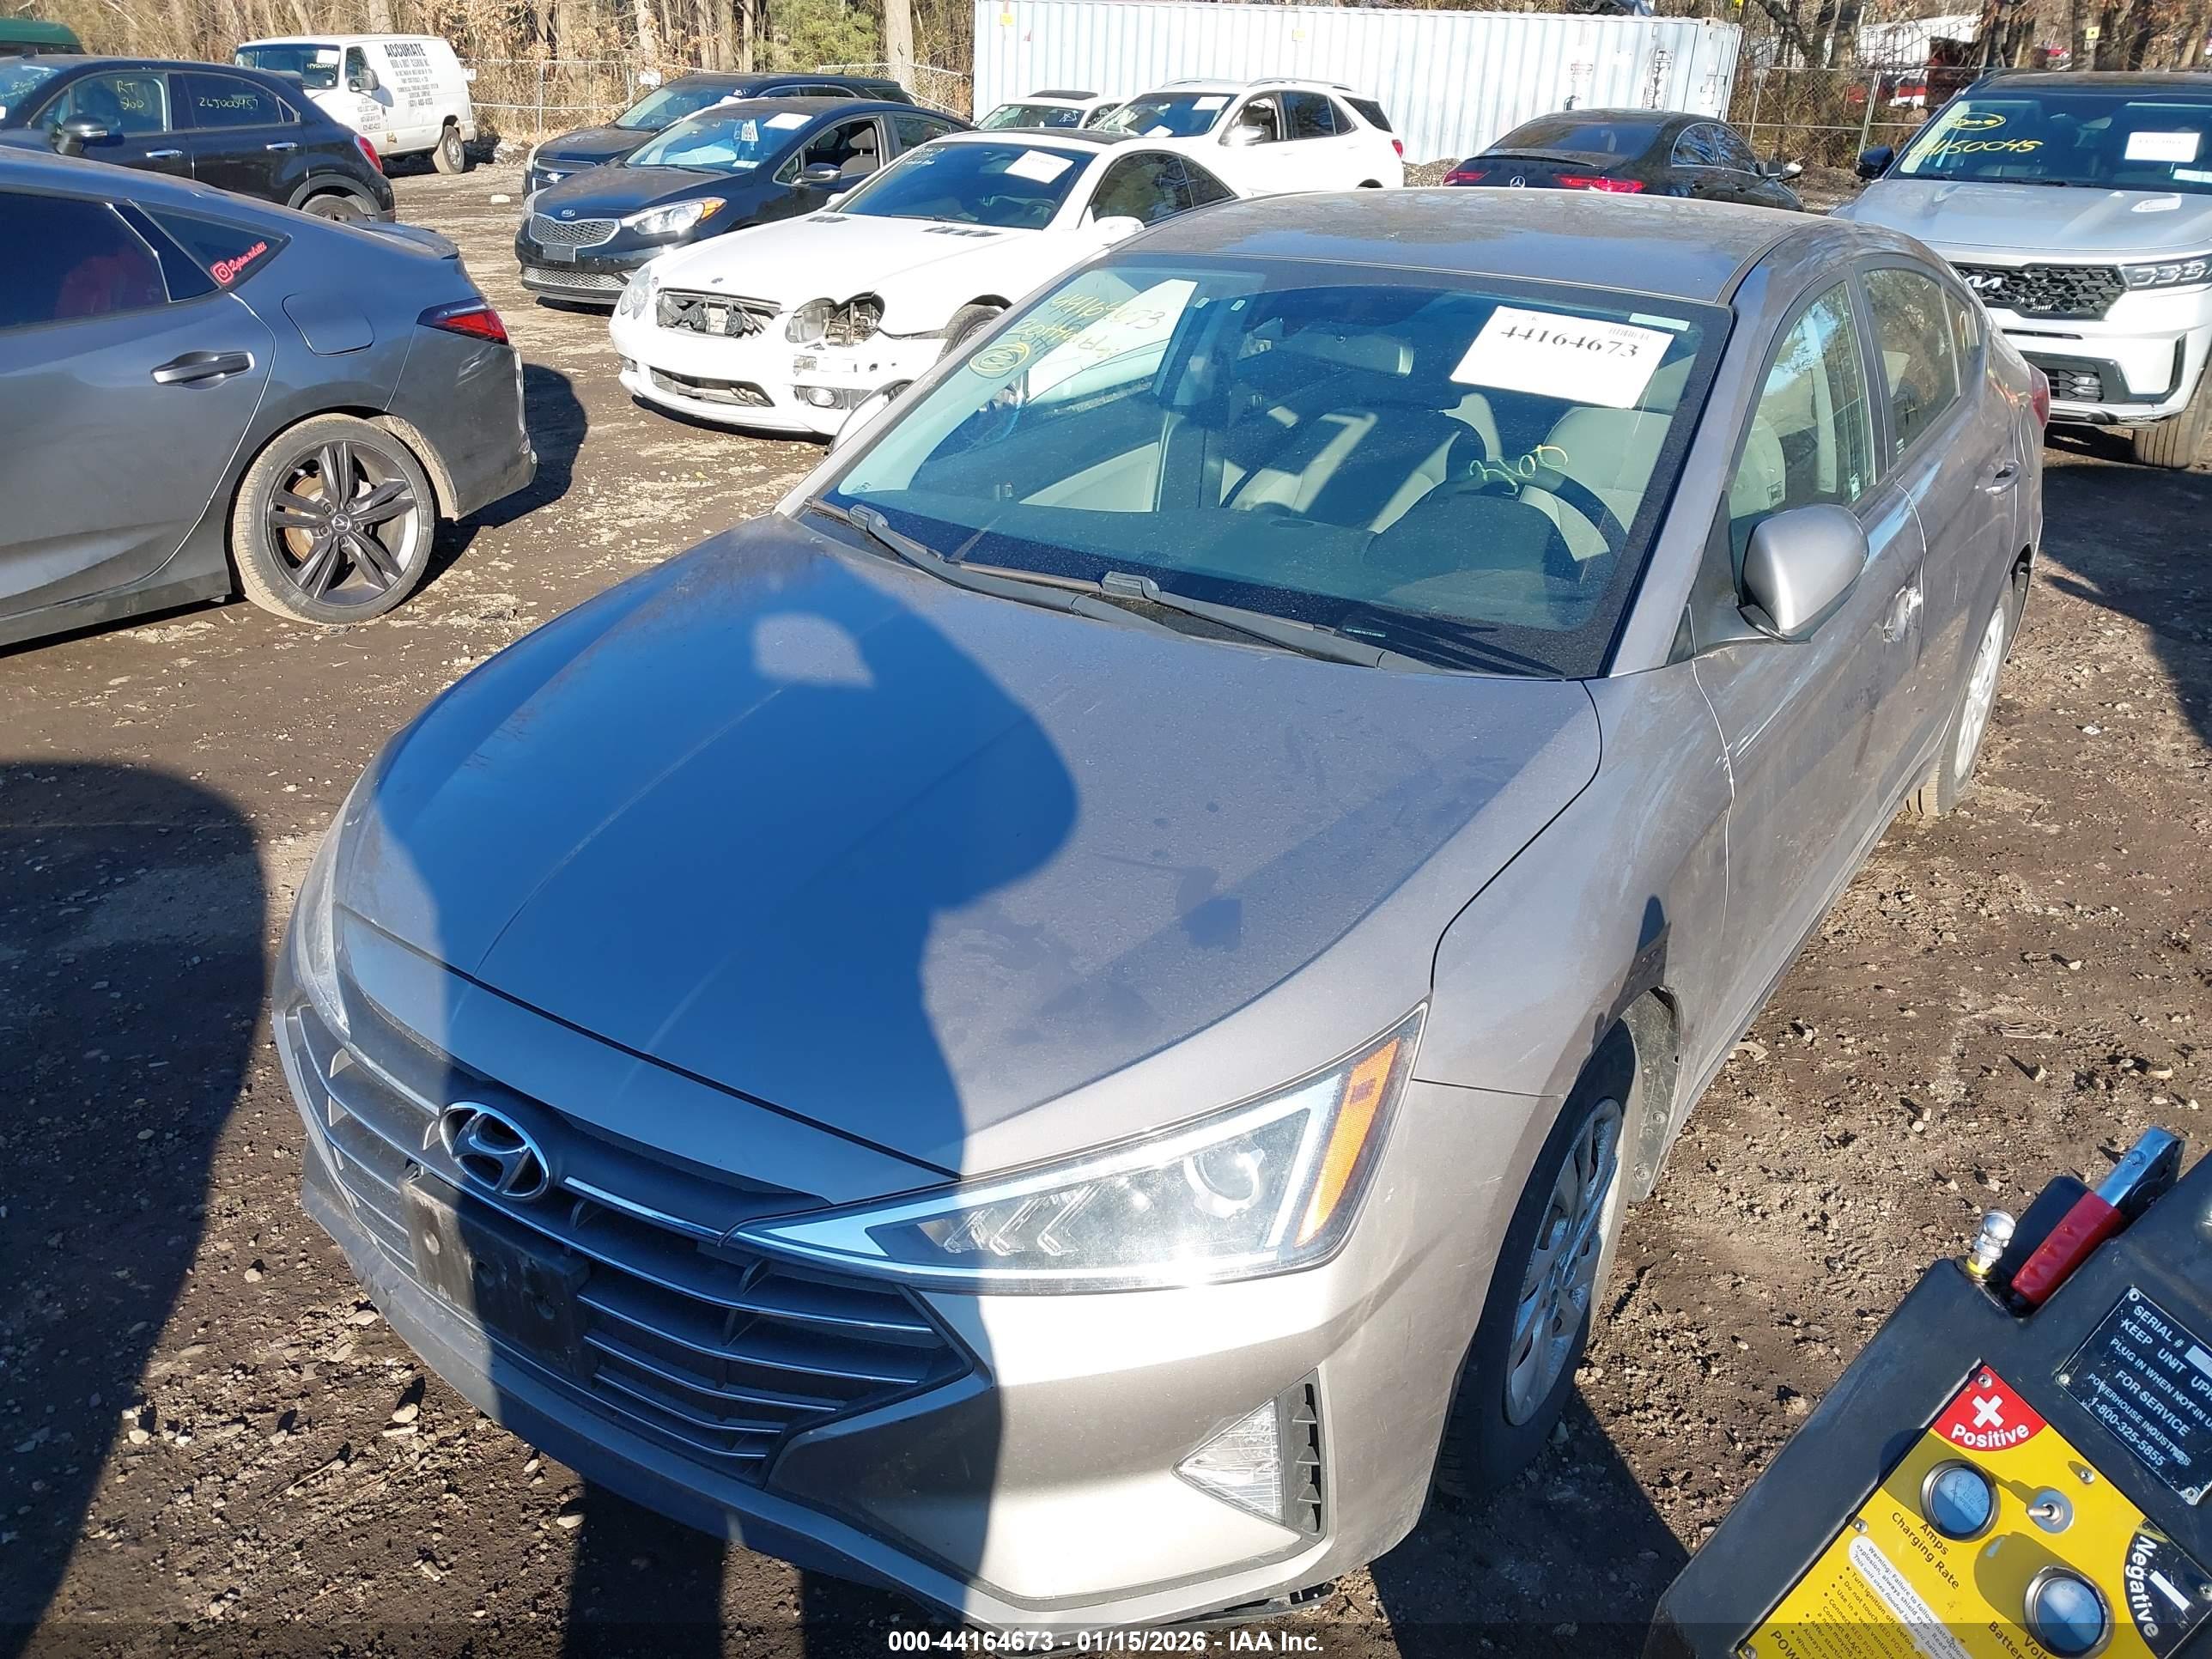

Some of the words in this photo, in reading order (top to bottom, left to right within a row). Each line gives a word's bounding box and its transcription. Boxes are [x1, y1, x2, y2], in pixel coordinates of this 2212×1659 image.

[384, 43, 426, 58] ACCURATE
[1500, 325, 1639, 357] 44164673
[2120, 1318, 2153, 1344] KEEP
[2157, 1347, 2187, 1373] UNIT
[2133, 1305, 2172, 1342] SERIAL
[2110, 1338, 2136, 1361] PLUG
[2134, 1358, 2147, 1370] IN
[2145, 1366, 2174, 1394] WHEN
[2087, 1373, 2144, 1424] POWERHOUSE
[2115, 1370, 2141, 1394] FOR
[2139, 1390, 2191, 1437] SERVICE
[1951, 1422, 2030, 1448] Positive
[2087, 1397, 2166, 1466] 1-800-325-5855
[1891, 1511, 1936, 1563] Charging
[1936, 1559, 1960, 1590] Rate
[1919, 1523, 1949, 1556] Amps
[1837, 1589, 1848, 1603] Use
[1847, 1601, 1854, 1611] in
[1858, 1616, 1871, 1631] well
[1851, 1571, 1864, 1589] Turn
[1864, 1587, 1886, 1615] ignition
[1896, 1626, 1915, 1650] before
[1863, 1566, 1875, 1579] unit
[1873, 1578, 1885, 1593] uses
[1884, 1592, 1905, 1614] flooded
[1902, 1613, 1917, 1627] lead
[1891, 1573, 1911, 1596] Failure
[1910, 1595, 1917, 1604] to
[2124, 1534, 2160, 1638] Negative
[1810, 1620, 1825, 1636] After
[1822, 1606, 1844, 1633] Connect
[1844, 1632, 1863, 1656] BLACK
[1828, 1598, 1853, 1627] Connect
[1850, 1626, 1863, 1641] RED
[1862, 1640, 1875, 1656] POS
[1844, 1580, 1852, 1591] Do
[1851, 1591, 1863, 1604] not
[1862, 1602, 1878, 1624] touch
[1877, 1622, 1891, 1638] RED
[1890, 1637, 1904, 1653] POS
[1881, 1574, 1900, 1596] always
[1900, 1595, 1917, 1616] shield
[1931, 1632, 1948, 1650] Read
[1796, 1635, 1811, 1657] When
[1802, 1627, 1823, 1652] Always
[1822, 1618, 1832, 1631] non
[1832, 1631, 1853, 1658] moving
